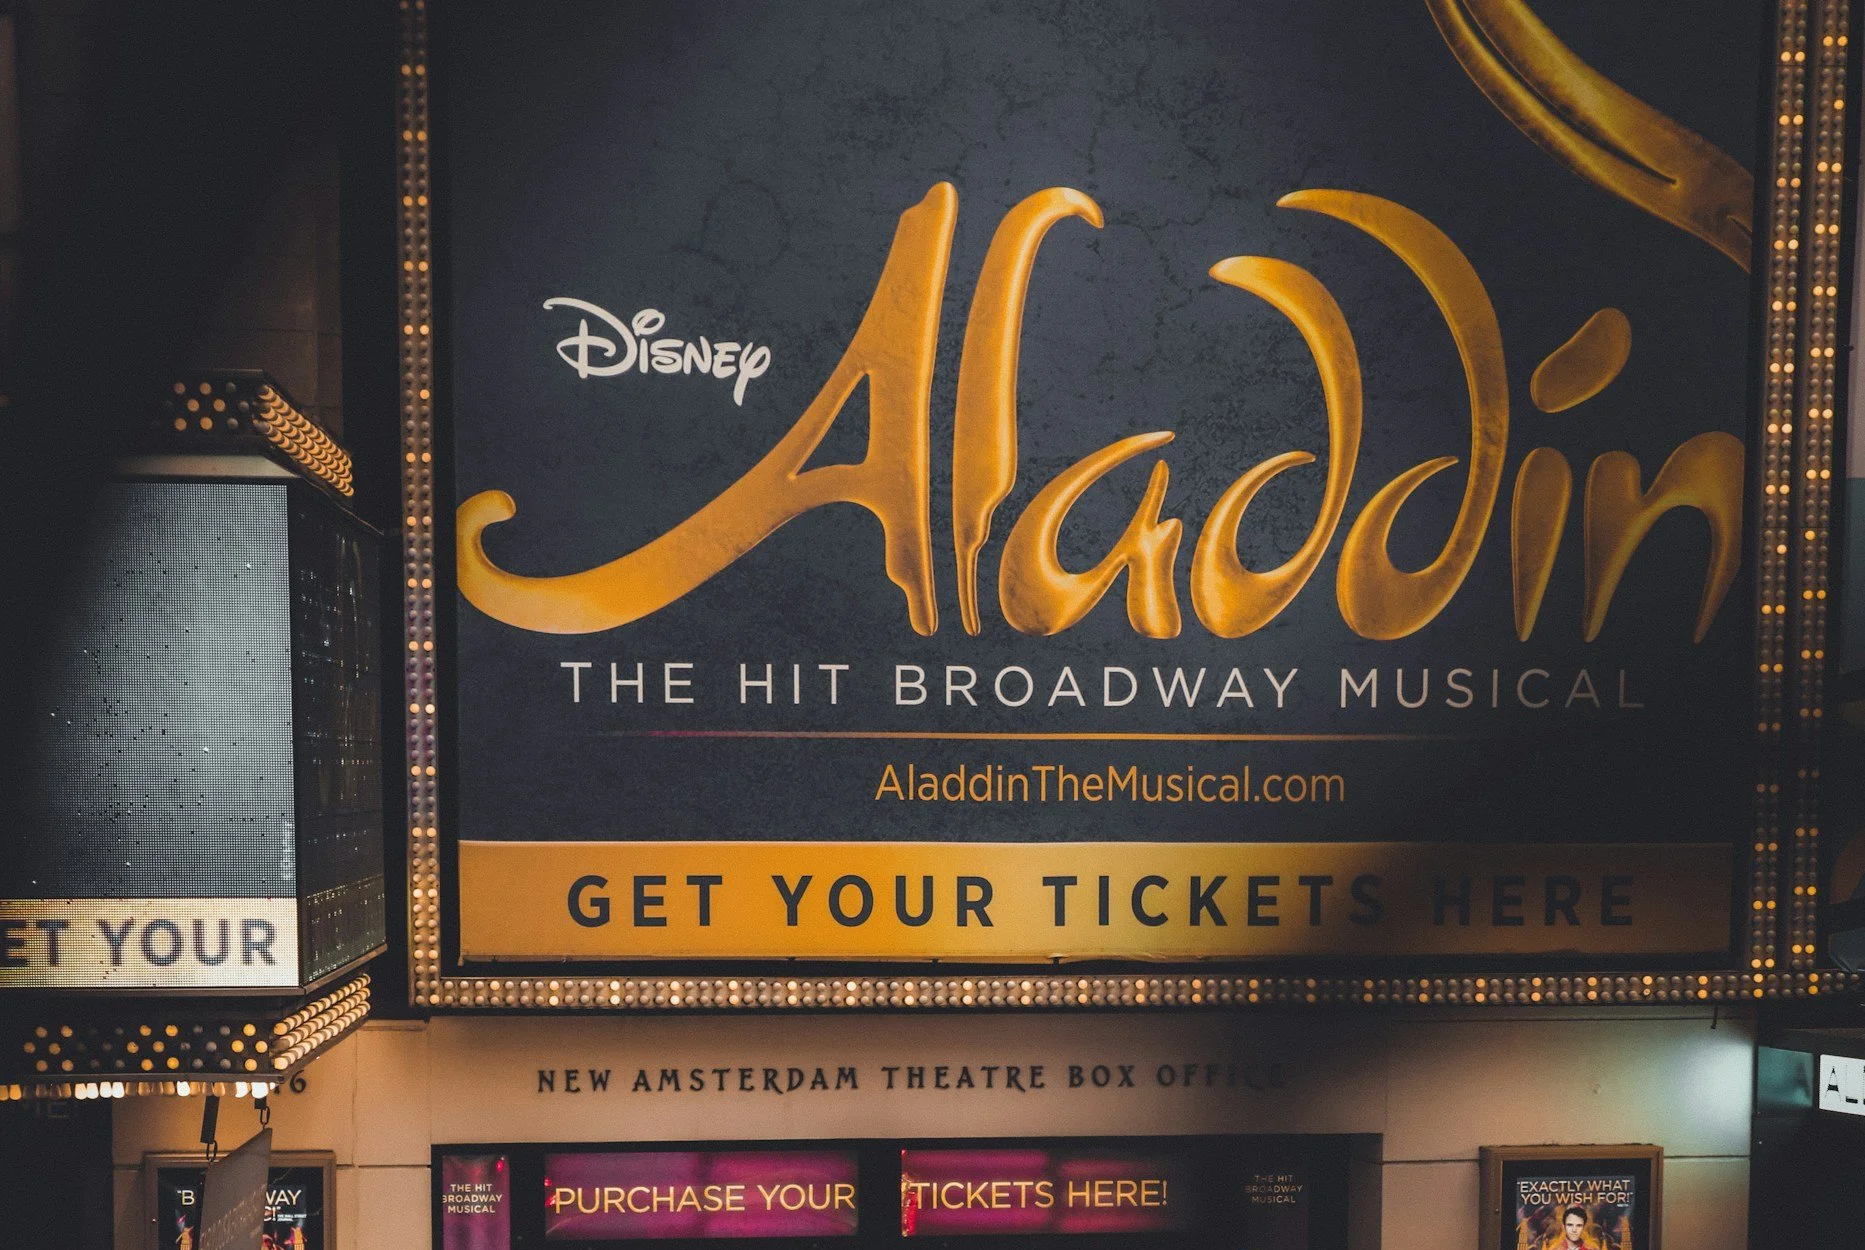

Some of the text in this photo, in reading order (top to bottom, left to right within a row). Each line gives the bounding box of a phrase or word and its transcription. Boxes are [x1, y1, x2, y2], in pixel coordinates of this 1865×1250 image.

[456, 181, 1744, 643] Aladdin
[560, 661, 1645, 710] THE HIT BROADWAY MUSICAL
[874, 763, 1346, 805] AladdinTheMusical.com
[567, 874, 1634, 929] GET YOUR TICKETS HERE
[97, 918, 276, 966] YOUR
[537, 1066, 613, 1094] NEW
[633, 1064, 860, 1095] AMSTERDAM
[880, 1062, 1047, 1093] THEATRE
[1067, 1063, 1136, 1090] BOX
[449, 1183, 493, 1193] THE HIT
[907, 1177, 1169, 1211] TICKETS HERE!
[1277, 1174, 1294, 1183] HIT
[1586, 1179, 1631, 1192] WHAT
[441, 1193, 503, 1204] BROADWAY
[447, 1204, 496, 1214] MUSICAL
[554, 1182, 857, 1216] PURCHASE YOUR
[1251, 1195, 1297, 1204] MUSICAL
[1520, 1193, 1552, 1206] YOU
[1555, 1192, 1593, 1205] WISH
